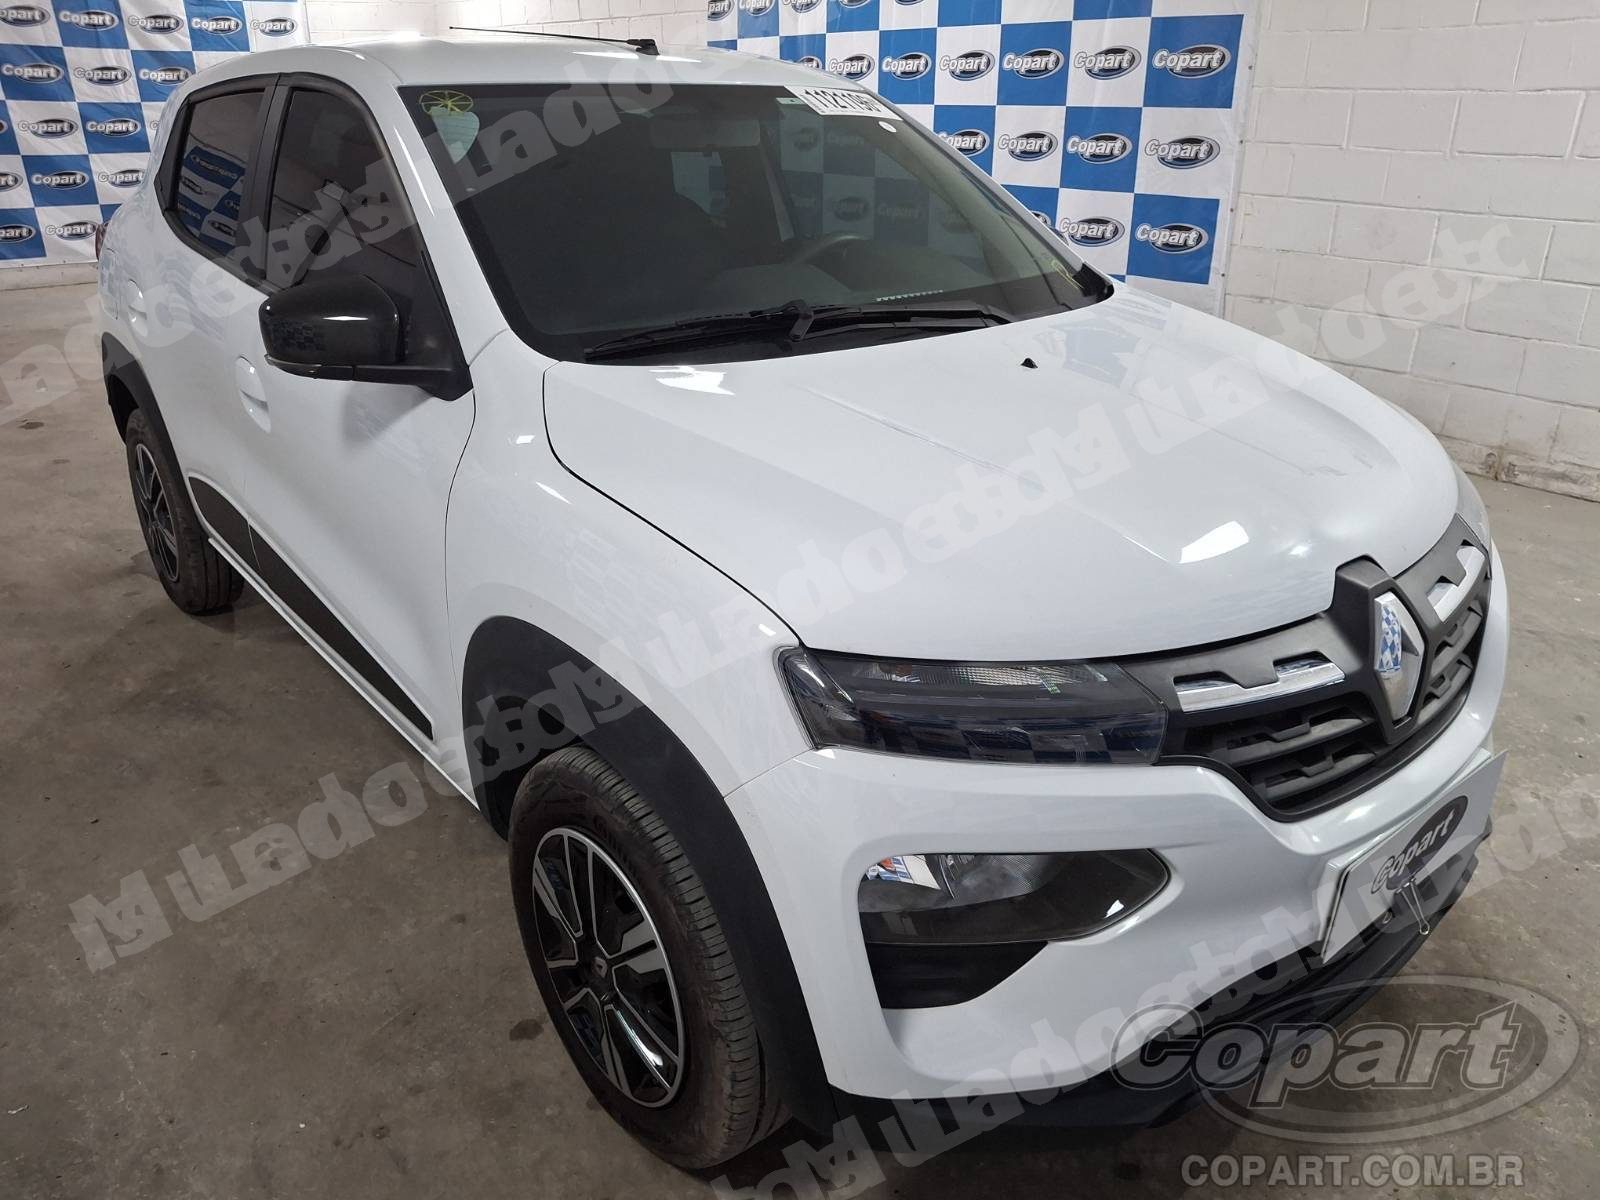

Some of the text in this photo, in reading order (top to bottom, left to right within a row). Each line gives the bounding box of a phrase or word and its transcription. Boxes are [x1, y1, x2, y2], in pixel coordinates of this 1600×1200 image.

[0, 8, 41, 21] opart
[59, 10, 112, 26] Copart
[127, 15, 177, 29] Copart
[191, 17, 237, 31] Copart
[250, 18, 293, 32] Copart
[829, 58, 868, 73] Copart
[881, 56, 927, 75] Copart
[938, 54, 990, 75] Copart
[1002, 53, 1057, 72] Copart
[1073, 51, 1132, 73] Copart
[1152, 49, 1222, 72] Copart
[1, 64, 57, 79] Copart
[74, 66, 125, 81] Copart
[138, 68, 186, 82] Copart
[18, 121, 71, 136] Copart
[86, 121, 136, 135] Copart
[998, 134, 1051, 154] Copart
[1067, 135, 1126, 156] Copart
[1145, 138, 1212, 160] Copart
[31, 173, 83, 187] Copart
[98, 171, 145, 185] Copart
[45, 224, 94, 239] Copart
[1059, 217, 1114, 238] Copart
[1136, 223, 1199, 245] Copart
[1371, 808, 1456, 894] Copart
